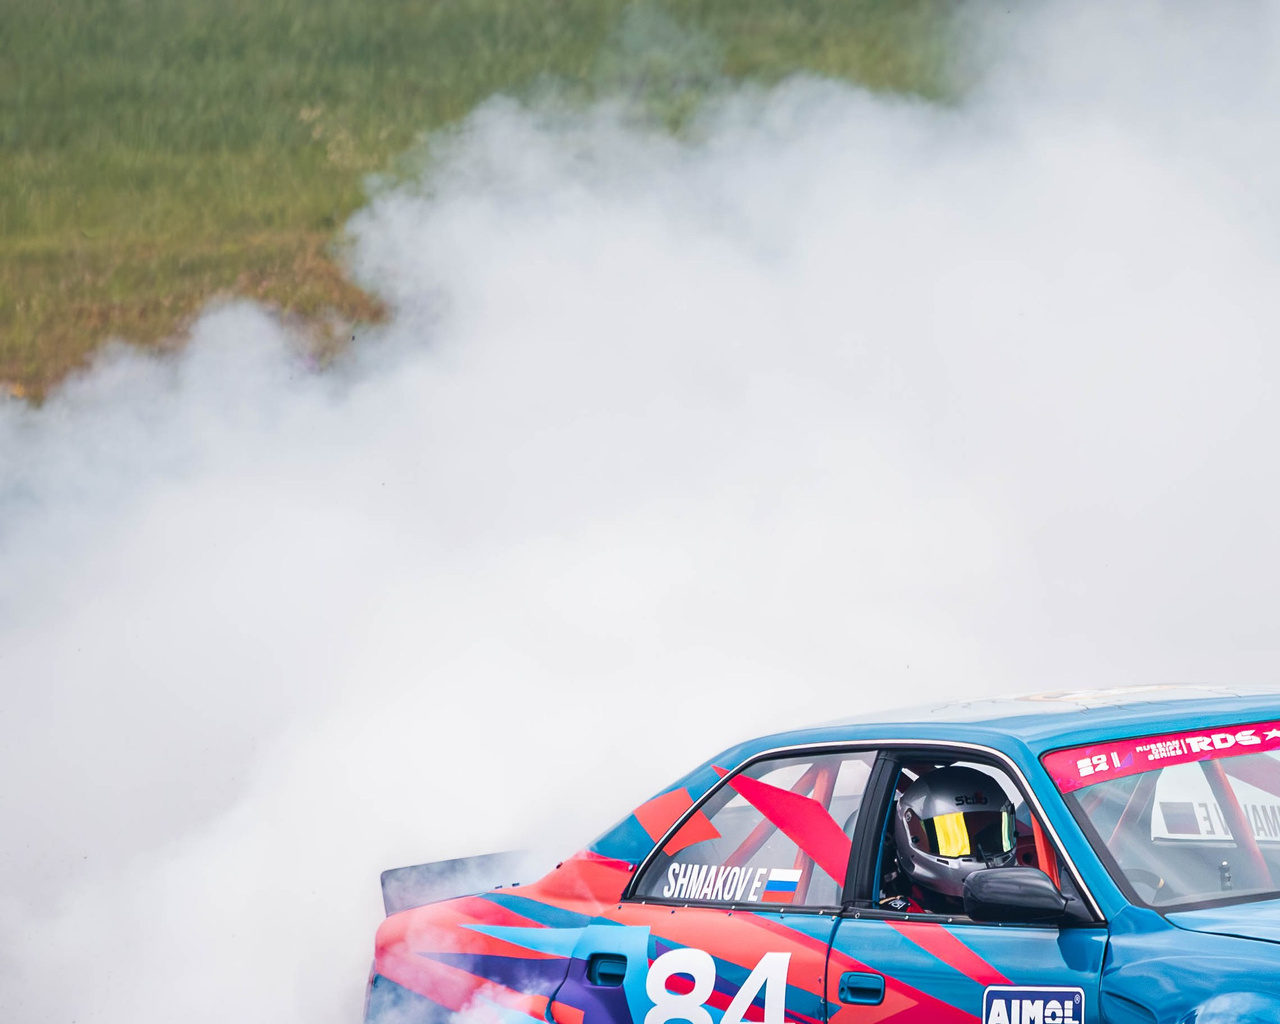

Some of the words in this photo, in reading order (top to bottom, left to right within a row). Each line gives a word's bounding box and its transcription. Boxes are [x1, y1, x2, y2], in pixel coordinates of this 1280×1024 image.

[1135, 739, 1180, 753] RUSSIAN
[1185, 729, 1261, 753] RDS
[1147, 749, 1183, 761] SERIES
[663, 862, 754, 901] SHMAKOV
[748, 867, 768, 902] E
